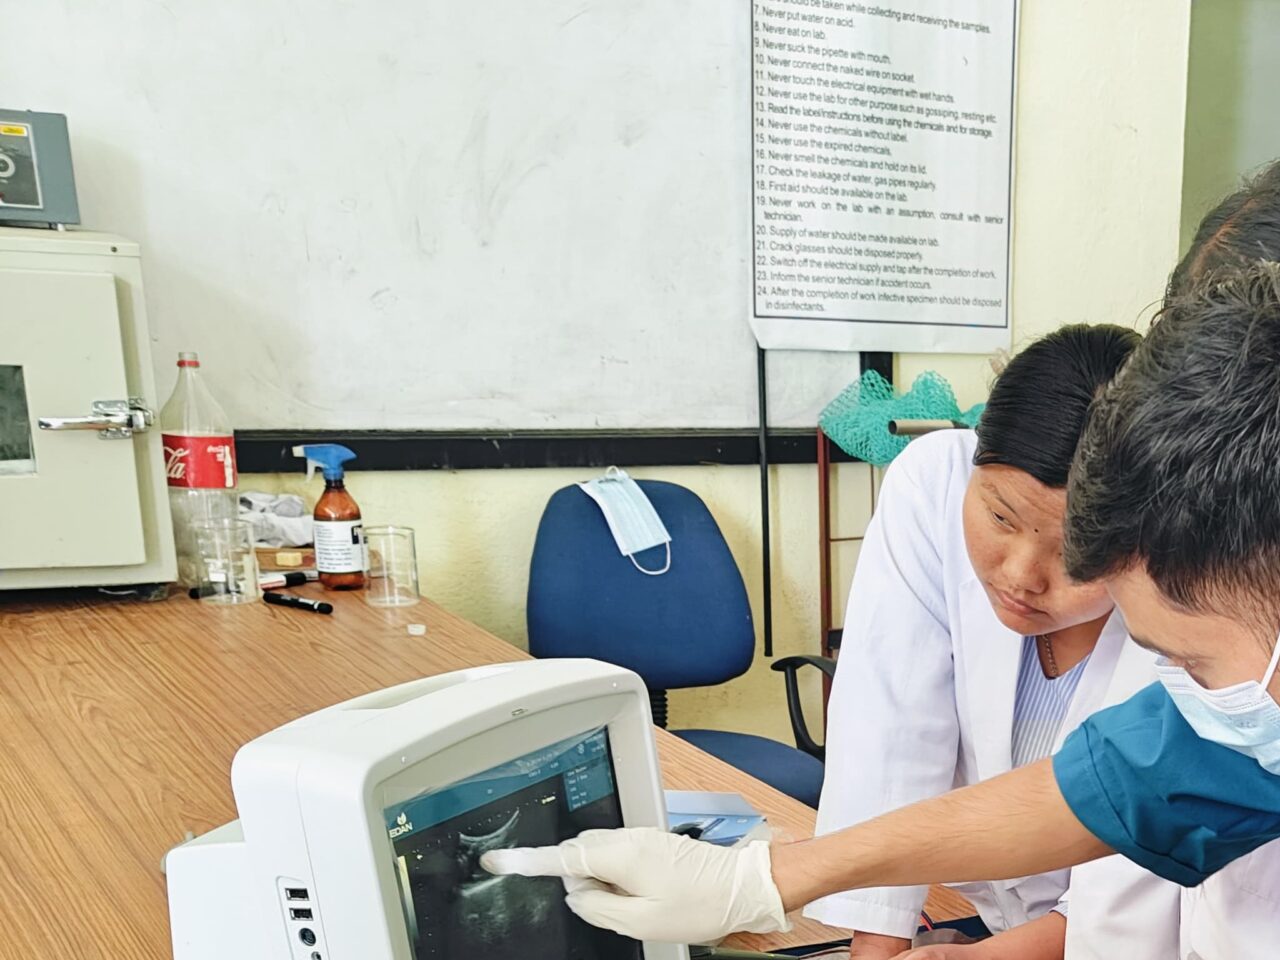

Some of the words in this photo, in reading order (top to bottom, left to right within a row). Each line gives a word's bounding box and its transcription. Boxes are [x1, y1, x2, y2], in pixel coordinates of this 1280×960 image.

[763, 6, 786, 18] Never
[787, 10, 800, 22] put
[801, 12, 823, 23] water
[825, 16, 834, 24] on
[823, 0, 844, 10] taken
[847, 2, 865, 13] while
[867, 6, 900, 21] collecting
[917, 14, 947, 29] receiving
[949, 17, 959, 28] the
[763, 22, 786, 34] Never
[787, 26, 800, 36] eat
[801, 29, 811, 37] on
[763, 39, 786, 50] Never
[788, 43, 805, 52] suck
[808, 44, 820, 54] the
[822, 46, 848, 59] pipette
[851, 49, 865, 60] with
[768, 55, 791, 67] Never
[793, 60, 824, 70] connect
[826, 62, 838, 72] the
[840, 65, 863, 75] naked
[866, 67, 880, 77] wire
[882, 71, 891, 79] on
[768, 71, 791, 82] Never
[793, 74, 815, 85] touch
[817, 76, 829, 87] the
[831, 79, 864, 91] electrical
[867, 84, 904, 97] equipment
[905, 88, 918, 98] with
[920, 90, 931, 100] wet
[768, 87, 791, 98] Never
[793, 92, 807, 100] use
[810, 91, 821, 101] the
[824, 93, 835, 103] lab
[837, 94, 847, 104] for
[849, 96, 868, 106] other
[870, 100, 897, 111] purpose
[900, 102, 914, 112] such
[917, 105, 924, 113] as
[962, 110, 984, 124] resting
[768, 103, 787, 114] Read
[790, 105, 800, 115] the
[863, 113, 883, 124] before
[886, 116, 901, 129] using
[903, 117, 912, 127] the
[914, 119, 944, 131] chemicals
[947, 123, 958, 132] and
[768, 119, 792, 130] Never
[793, 123, 808, 132] use
[810, 123, 822, 133] the
[824, 124, 862, 137] chemicals
[864, 128, 890, 139] without
[768, 135, 792, 146] Never
[794, 139, 808, 147] use
[810, 138, 823, 148] the
[825, 140, 853, 152] expired
[769, 150, 792, 161] Never
[794, 153, 815, 163] smell
[817, 154, 829, 164] the
[831, 156, 868, 168] chemicals
[870, 160, 883, 169] and
[885, 160, 900, 171] hold
[901, 164, 908, 172] on
[769, 166, 793, 176] Check
[796, 167, 808, 177] the
[810, 168, 841, 182] leakage
[843, 171, 850, 181] of
[874, 176, 887, 186] gas
[889, 176, 906, 188] pipes
[769, 181, 786, 192] First
[788, 183, 799, 192] aid
[802, 184, 828, 195] should
[830, 185, 839, 195] be
[841, 187, 873, 198] available
[875, 191, 883, 199] on
[886, 190, 896, 200] the
[769, 197, 792, 207] Never
[797, 199, 816, 209] work
[821, 202, 831, 210] on
[837, 201, 847, 211] the
[853, 202, 863, 212] lab
[868, 204, 882, 214] with
[886, 207, 894, 215] an
[940, 210, 963, 220] consult
[968, 212, 980, 222] with
[985, 214, 1004, 224] senior
[770, 226, 796, 240] Supply
[798, 228, 806, 237] of
[808, 229, 830, 239] water
[832, 230, 856, 241] should
[858, 232, 866, 241] be
[868, 233, 887, 243] made
[890, 234, 917, 245] available
[919, 238, 927, 246] on
[770, 241, 793, 252] Crack
[795, 243, 825, 255] glasses
[828, 245, 852, 255] should
[854, 246, 862, 256] be
[864, 247, 895, 260] disposed
[770, 256, 796, 267] Switch
[799, 258, 808, 268] off
[810, 258, 822, 268] the
[824, 259, 857, 270] electrical
[860, 262, 882, 275] supply
[883, 263, 895, 273] and
[897, 263, 906, 276] tap
[908, 264, 922, 274] after
[924, 265, 933, 275] the
[935, 267, 970, 279] completion
[972, 268, 979, 278] of
[771, 271, 795, 281] Inform
[798, 272, 809, 282] the
[812, 274, 835, 284] senior
[838, 274, 874, 286] technician
[881, 277, 908, 288] accident
[766, 299, 772, 309] in
[771, 287, 789, 297] After
[792, 287, 804, 297] the
[806, 289, 849, 301] completion
[851, 290, 858, 300] of
[861, 291, 875, 301] work
[907, 294, 937, 306] specimen
[940, 295, 960, 305] should
[962, 296, 970, 306] be
[972, 296, 1001, 309] disposed
[389, 822, 413, 838] EDAN
